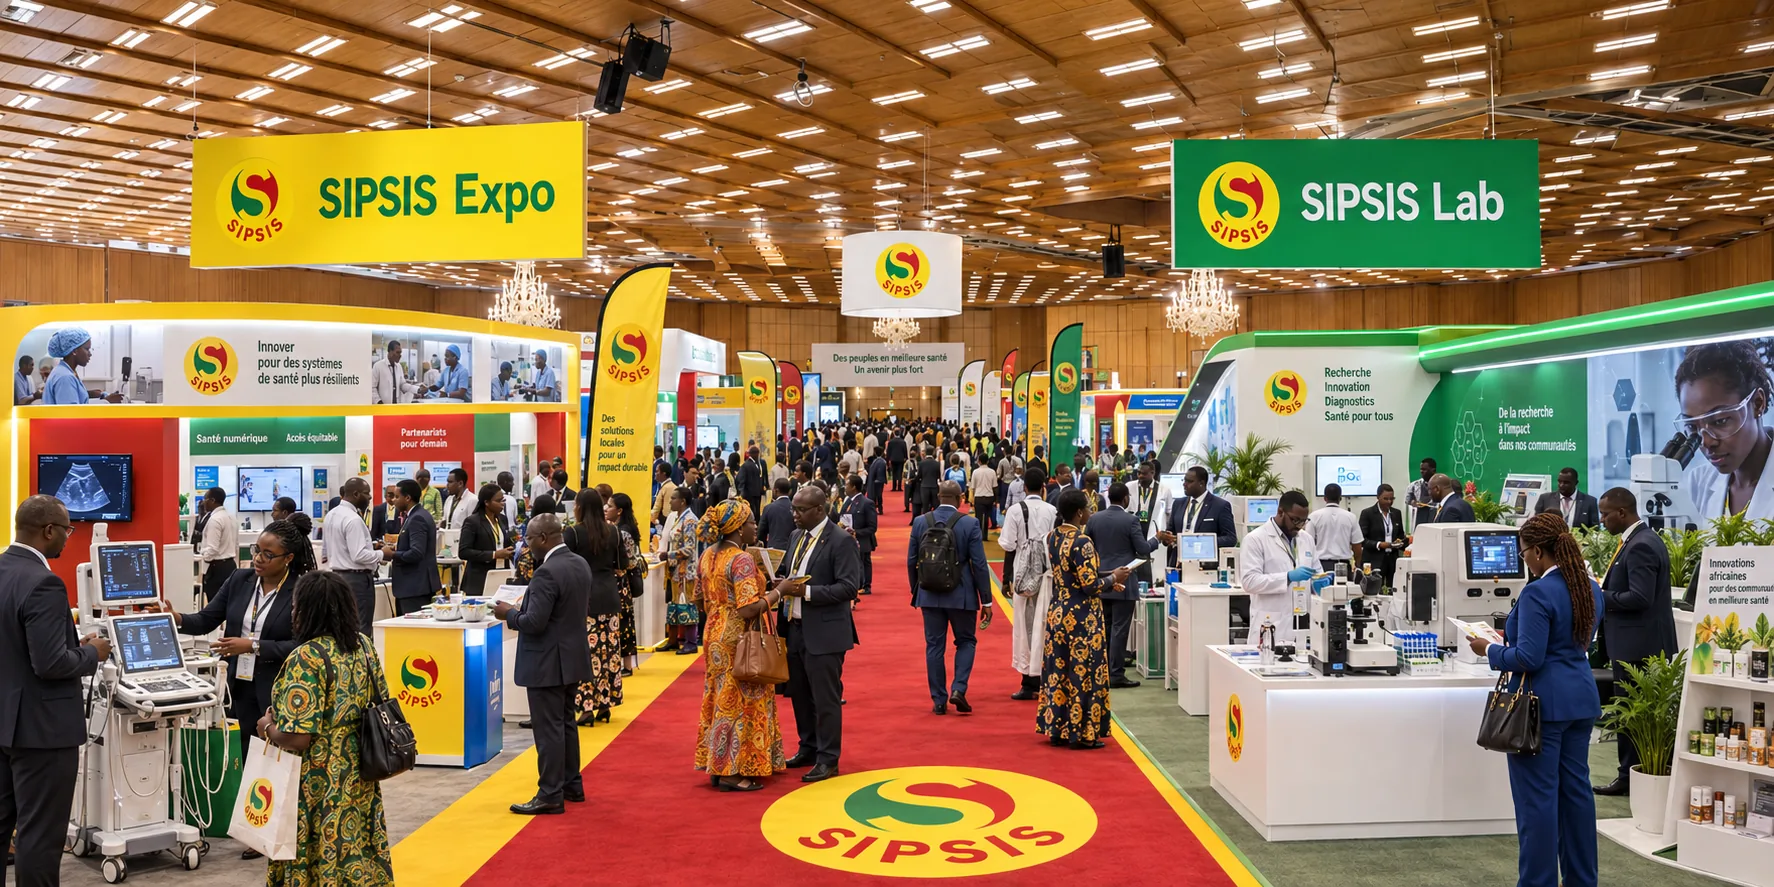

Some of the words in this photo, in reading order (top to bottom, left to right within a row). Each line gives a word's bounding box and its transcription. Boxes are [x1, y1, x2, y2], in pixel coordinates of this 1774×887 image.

[318, 174, 437, 219] SIPSIS
[455, 172, 555, 224] Expo
[1300, 181, 1420, 222] SIPSIS
[1433, 180, 1505, 221] Lab
[227, 218, 283, 242] SIPSIS
[1210, 220, 1268, 243] SIPSIS
[882, 280, 922, 296] SIPSIS
[258, 340, 294, 352] Innover
[258, 358, 280, 370] pour
[283, 357, 300, 368] des
[302, 357, 342, 371] systèmes
[833, 354, 848, 362] Des
[849, 354, 878, 363] peuples
[892, 353, 925, 362] meilleure
[927, 353, 947, 362] santé
[608, 365, 650, 382] SIPSIS
[854, 366, 864, 374] Un
[892, 366, 907, 375] plus
[1325, 367, 1371, 377] Recherche
[191, 376, 231, 392] SIPSIS
[258, 372, 270, 384] de
[273, 373, 299, 384] santé
[301, 373, 320, 387] plus
[322, 373, 359, 385] résilients
[1325, 382, 1370, 392] Innovation
[1270, 400, 1302, 414] SIPSIS
[1325, 396, 1374, 408] Diagnostics
[1325, 411, 1350, 421] Santé
[1352, 413, 1372, 423] pour
[1375, 412, 1394, 421] tous
[1499, 407, 1508, 418] De
[1510, 406, 1516, 418] la
[1518, 405, 1553, 418] recherche
[602, 414, 615, 422] Des
[401, 428, 446, 437] Partenariats
[601, 426, 634, 435] solutions
[1499, 423, 1502, 434] à
[196, 433, 221, 444] Santé
[223, 434, 268, 445] numérique
[308, 433, 338, 444] équitable
[401, 441, 418, 449] pour
[420, 440, 447, 448] demain
[600, 438, 624, 447] locales
[1499, 438, 1514, 450] dans
[1515, 442, 1527, 450] nos
[598, 452, 615, 460] pour
[597, 462, 620, 473] impact
[1710, 558, 1755, 568] Innovations
[1709, 571, 1747, 580] africaines
[1709, 585, 1724, 594] pour
[1725, 584, 1737, 592] des
[1750, 596, 1768, 604] santé
[398, 690, 442, 707] SIPSIS
[798, 825, 1065, 864] SIPSIS
